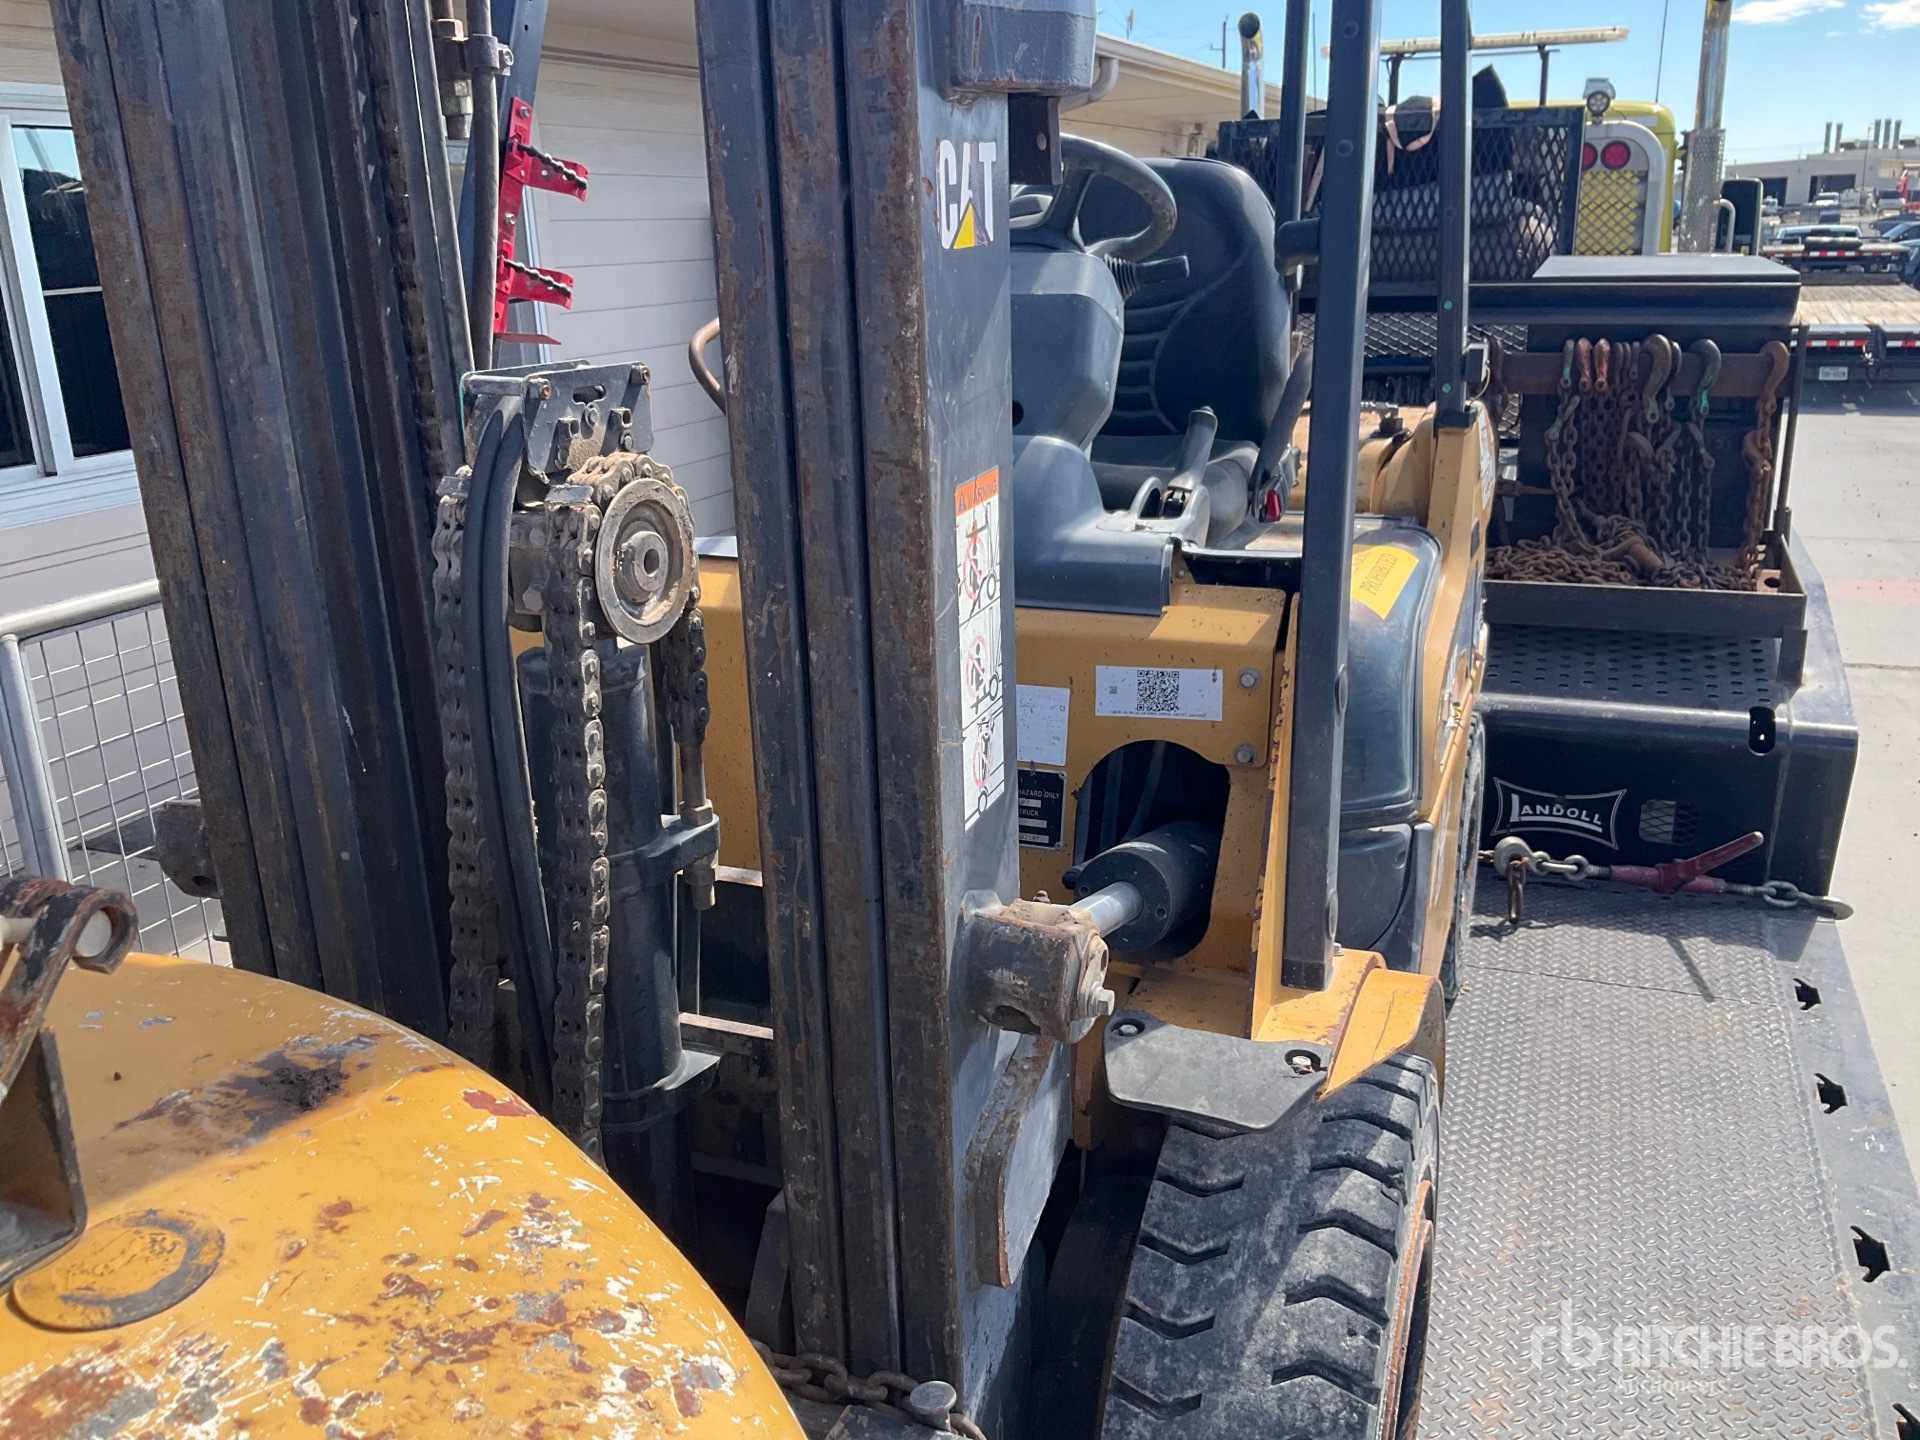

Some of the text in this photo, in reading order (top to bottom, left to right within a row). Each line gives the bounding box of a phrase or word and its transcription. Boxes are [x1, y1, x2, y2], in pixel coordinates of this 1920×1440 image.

[937, 139, 997, 250] CAT
[967, 479, 998, 508] WARNING
[1359, 552, 1398, 596] PROHIBITED
[1043, 791, 1061, 800] ONLY
[1510, 793, 1603, 829] LANDOLL
[1019, 809, 1040, 817] TRUCK
